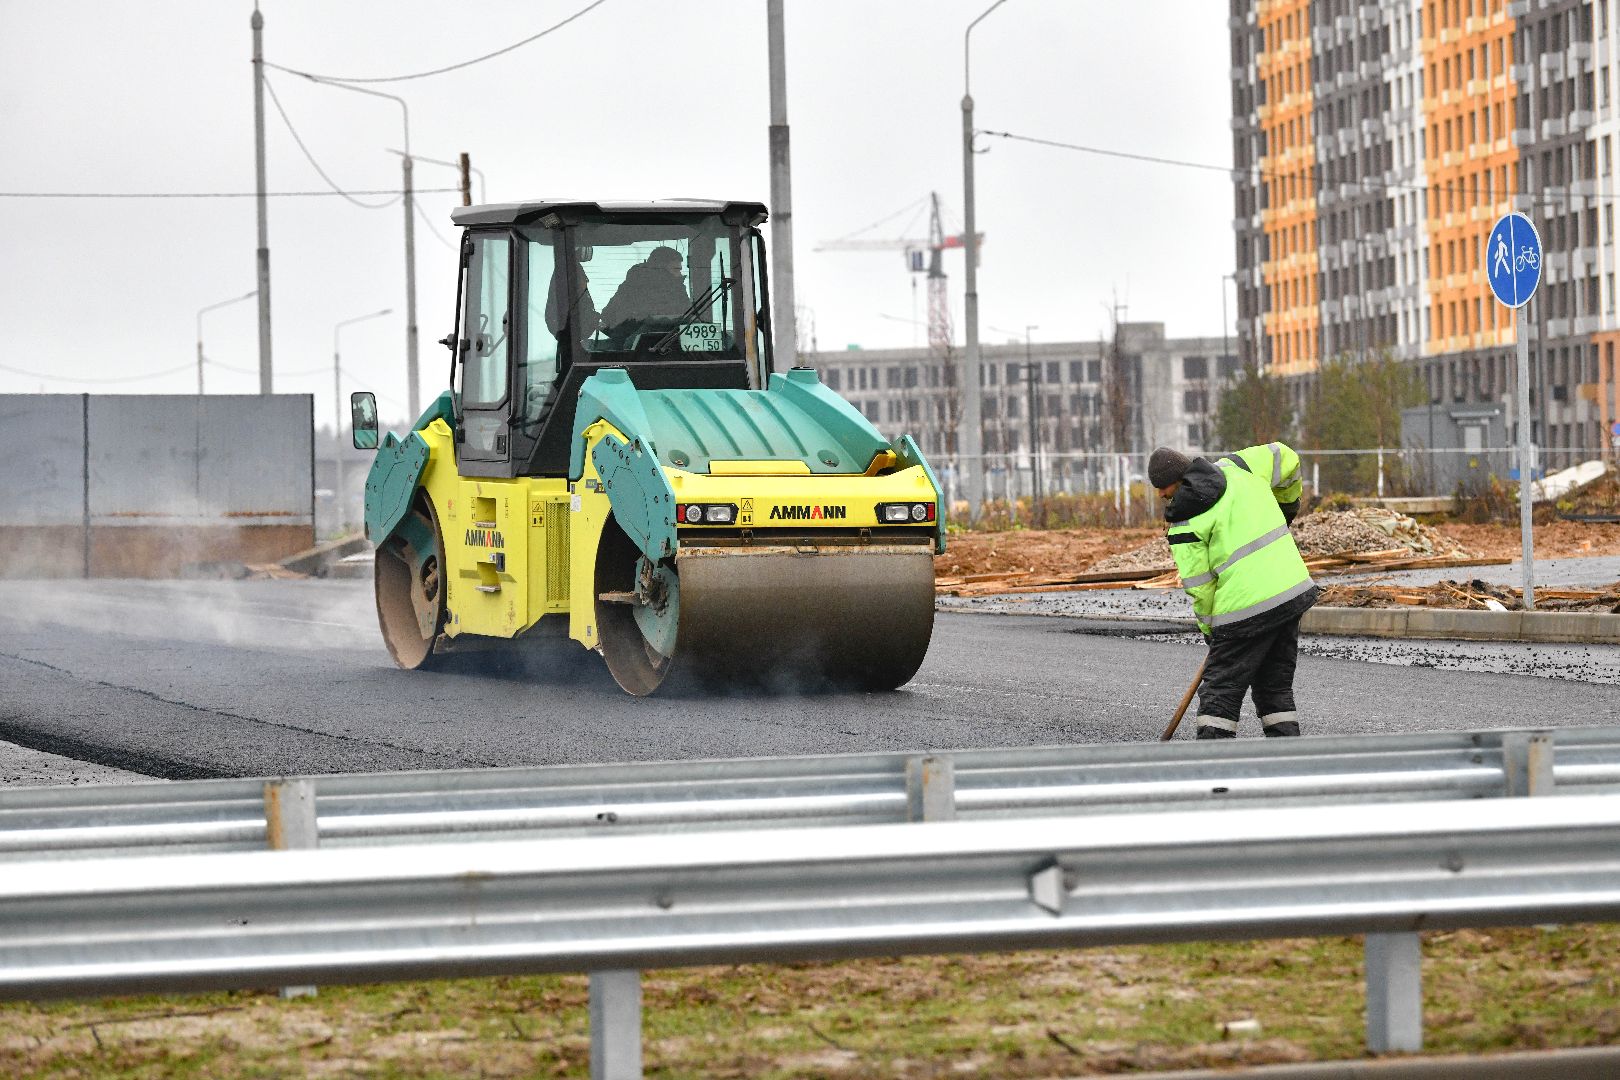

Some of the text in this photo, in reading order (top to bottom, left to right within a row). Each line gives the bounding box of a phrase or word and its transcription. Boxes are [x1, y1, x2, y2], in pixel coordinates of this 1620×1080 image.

[685, 324, 717, 338] 4989
[707, 340, 720, 351] 50
[769, 505, 846, 520] AMMANN
[464, 528, 505, 549] AMMANN
